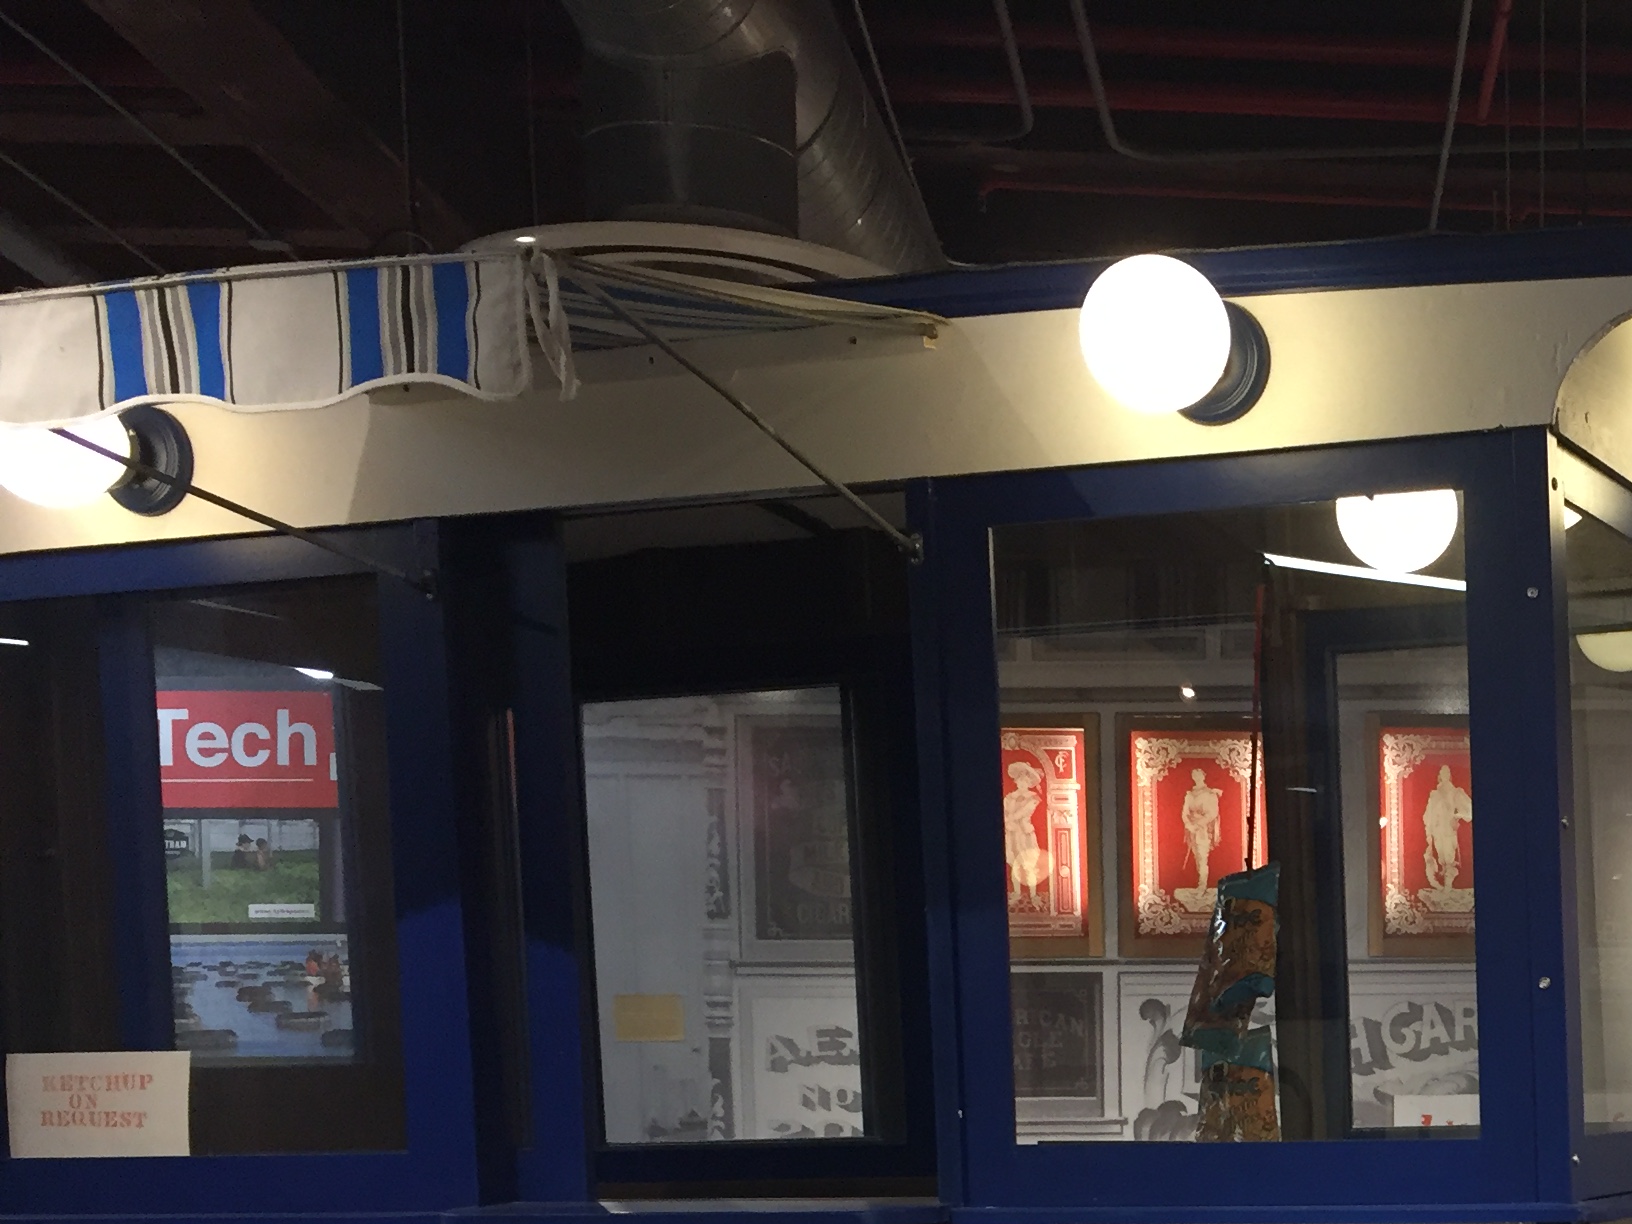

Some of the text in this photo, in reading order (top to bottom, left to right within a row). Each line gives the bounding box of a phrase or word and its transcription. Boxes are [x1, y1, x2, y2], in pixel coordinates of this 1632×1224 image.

[156, 708, 318, 768] Tech
[42, 1073, 153, 1093] KETCHUP
[68, 1094, 98, 1110] ON
[40, 1111, 148, 1129] REQUEST
